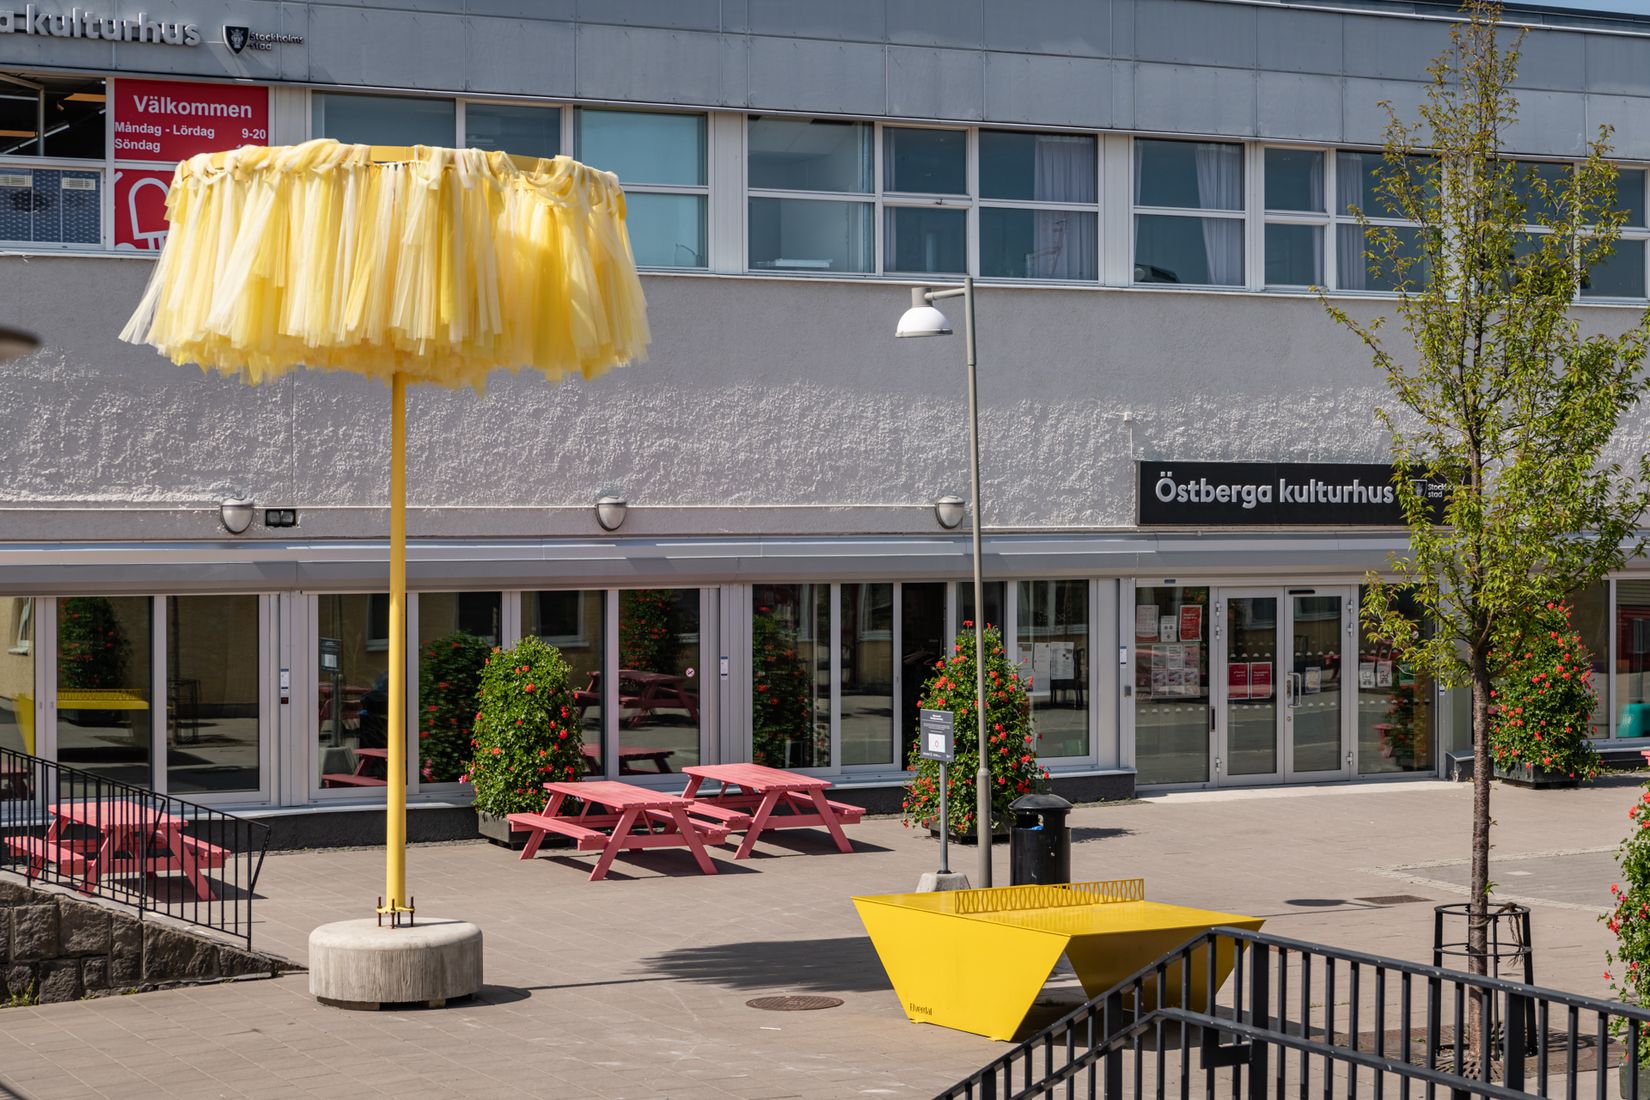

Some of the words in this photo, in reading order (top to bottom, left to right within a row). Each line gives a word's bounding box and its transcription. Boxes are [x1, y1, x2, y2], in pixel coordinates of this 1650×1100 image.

[26, 3, 201, 46] kulturhus
[249, 31, 304, 43] Stockholms
[133, 95, 252, 118] Välkommen
[115, 121, 162, 136] Måndag
[173, 124, 215, 139] Lördag
[241, 128, 266, 139] 9-20
[115, 138, 161, 153] Söndag
[1155, 471, 1272, 509] Östberga
[1279, 478, 1394, 504] kulturhus
